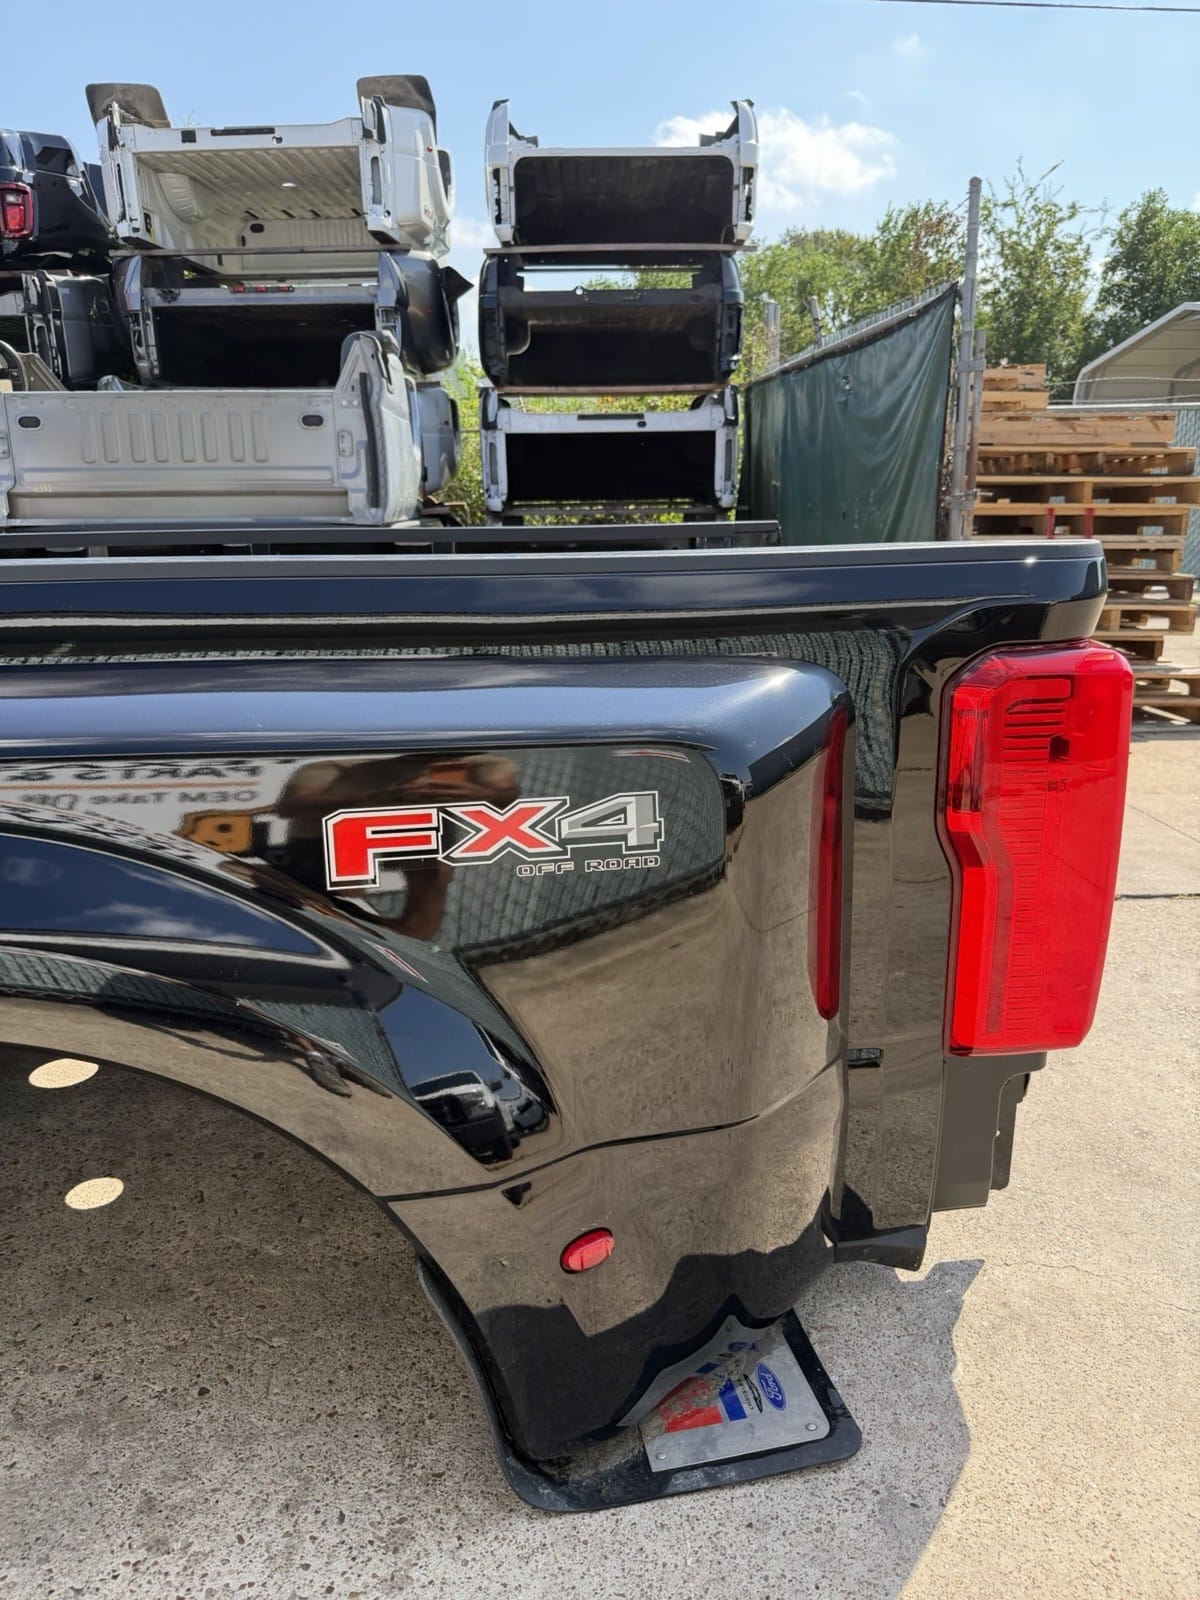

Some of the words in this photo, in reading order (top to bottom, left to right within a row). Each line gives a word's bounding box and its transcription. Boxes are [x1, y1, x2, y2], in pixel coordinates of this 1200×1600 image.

[322, 790, 665, 890] FX4
[516, 861, 575, 877] OFF
[585, 855, 661, 872] ROAD
[758, 1370, 783, 1403] Ford
